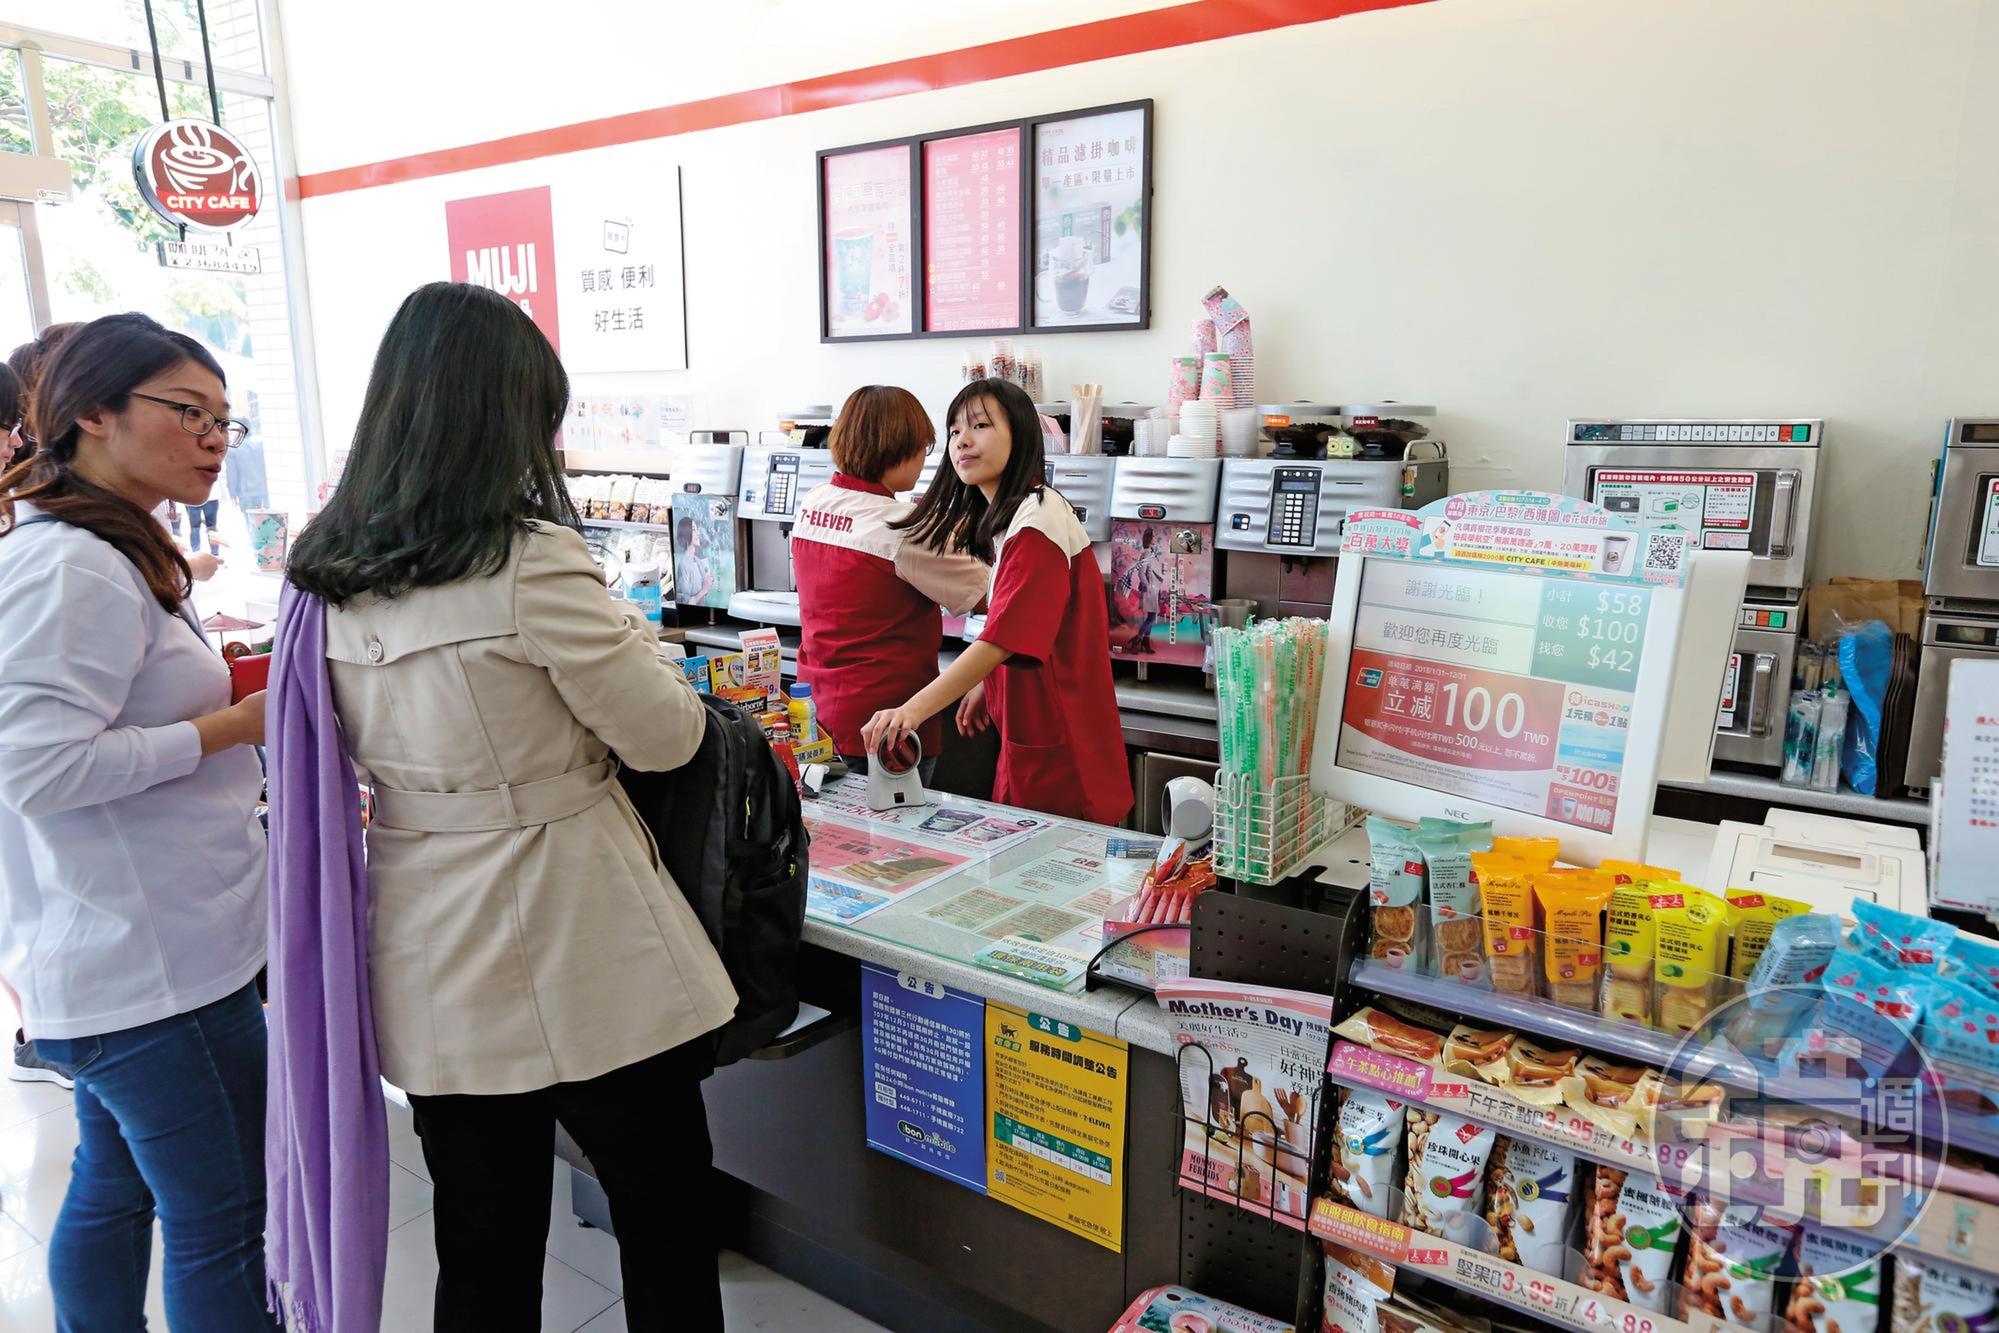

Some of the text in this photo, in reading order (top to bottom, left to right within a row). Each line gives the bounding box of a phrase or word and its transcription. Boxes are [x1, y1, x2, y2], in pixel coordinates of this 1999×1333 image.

[1041, 136, 1137, 166] 精品濾掛咖啡
[167, 196, 250, 209] CITY CAFE
[466, 243, 538, 295] MUJI
[581, 264, 655, 293] 質感 便利
[594, 307, 644, 332] 好生活
[1467, 504, 1560, 523] 東京/巴黎/西雅圖
[1350, 533, 1409, 551] 百萬大獎
[1506, 555, 1546, 565] CITY CAFE
[1404, 578, 1485, 604] 謝謝光臨！
[1546, 588, 1642, 615] 小計 $58
[1383, 621, 1500, 656] 歡迎您再度光臨
[1542, 614, 1639, 644] 收您 $100
[1538, 641, 1634, 673] 找您 $42
[1384, 682, 1549, 746] 立减 100 TWD
[1454, 732, 1478, 750] 500
[1571, 767, 1609, 790] 100
[1444, 808, 1469, 821] NEC
[1576, 803, 1612, 826] 咖啡
[1610, 910, 1651, 922] 法式奶香夾心
[1660, 937, 1703, 951] 法式奶香夾心
[907, 976, 935, 995] 公告
[1039, 1016, 1069, 1038] 公告
[1168, 1000, 1303, 1036] Mother's Day
[1029, 1040, 1117, 1079] 服務時間調整公告
[1427, 1141, 1481, 1166] 珍珠開心果
